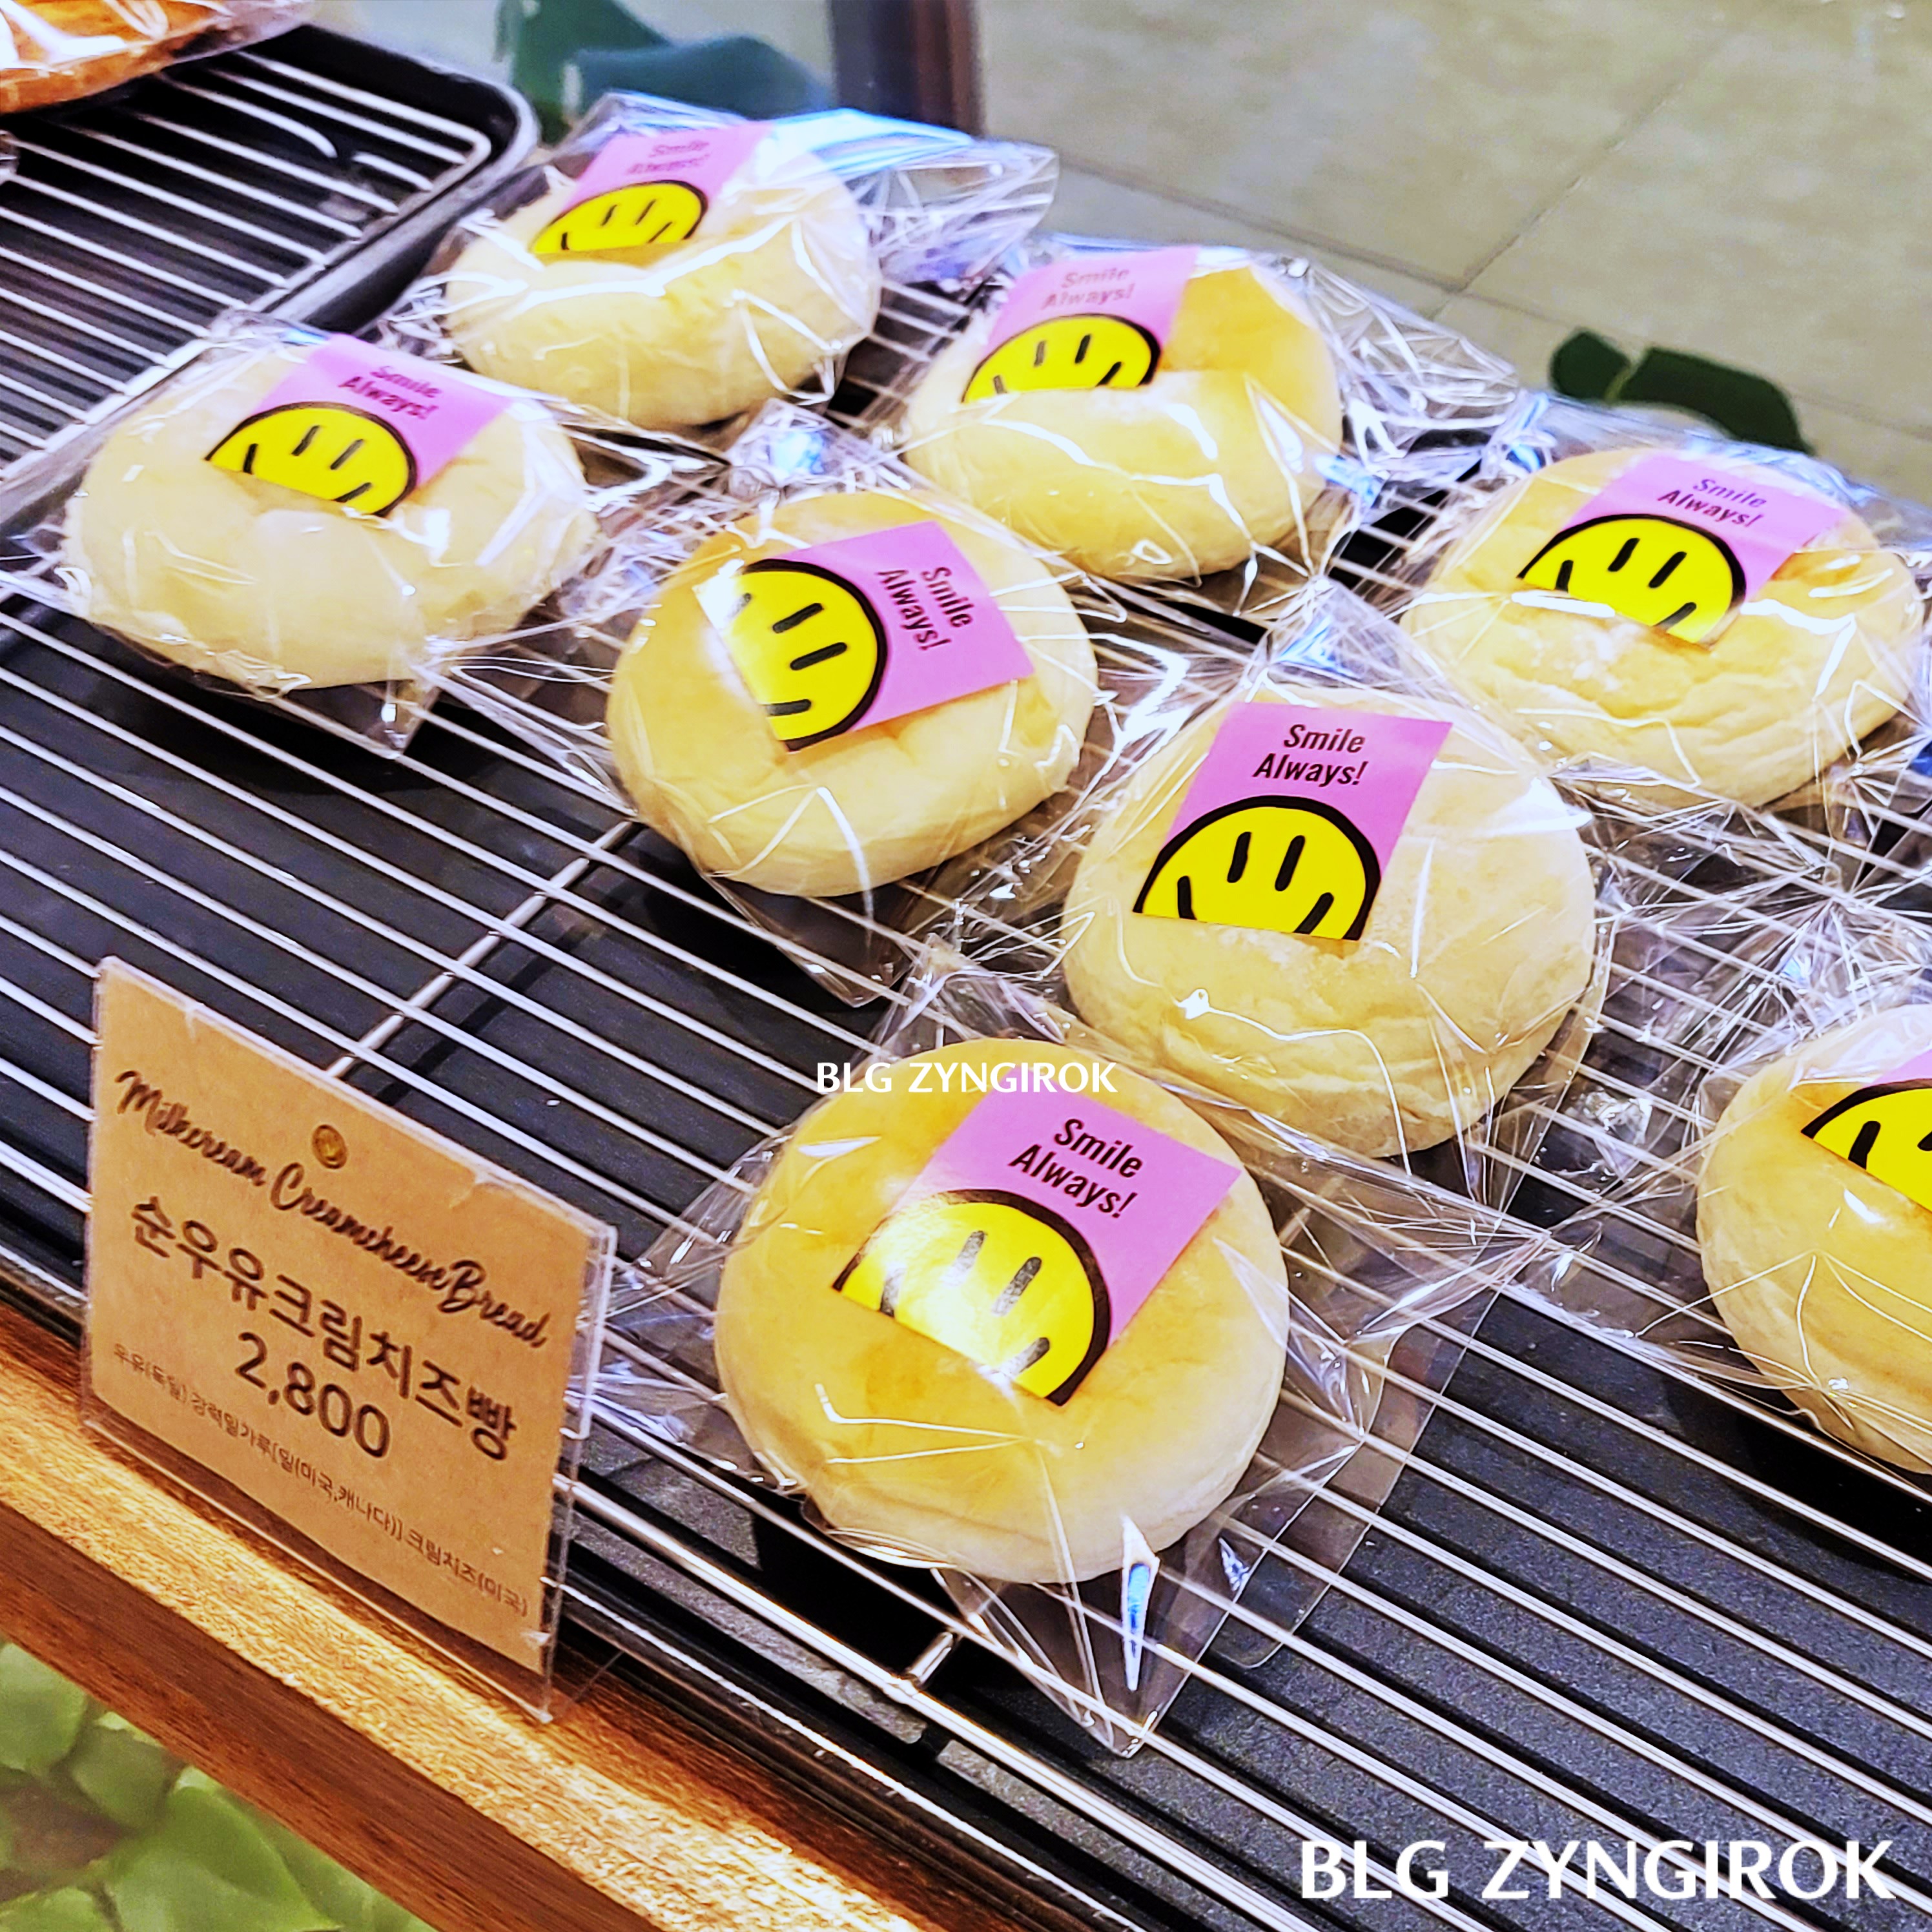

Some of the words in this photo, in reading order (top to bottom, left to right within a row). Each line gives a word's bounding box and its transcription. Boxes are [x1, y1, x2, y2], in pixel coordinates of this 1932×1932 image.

[1040, 282, 1136, 311] Always!
[1061, 267, 1130, 288] Smile
[337, 376, 440, 420] Always!
[1657, 489, 1765, 528] Always!
[1692, 478, 1767, 508] Smile
[875, 570, 952, 651] Always!
[920, 566, 975, 628] Smile
[1282, 723, 1366, 754] Smile
[1251, 752, 1370, 788] Always!
[1053, 1118, 1144, 1178] Smile
[1007, 1144, 1138, 1218] Always!
[131, 1196, 517, 1461] 순우유크림치즈빵
[234, 1331, 390, 1458] 2,800
[404, 1528, 528, 1618] 크림치즈(미국)
